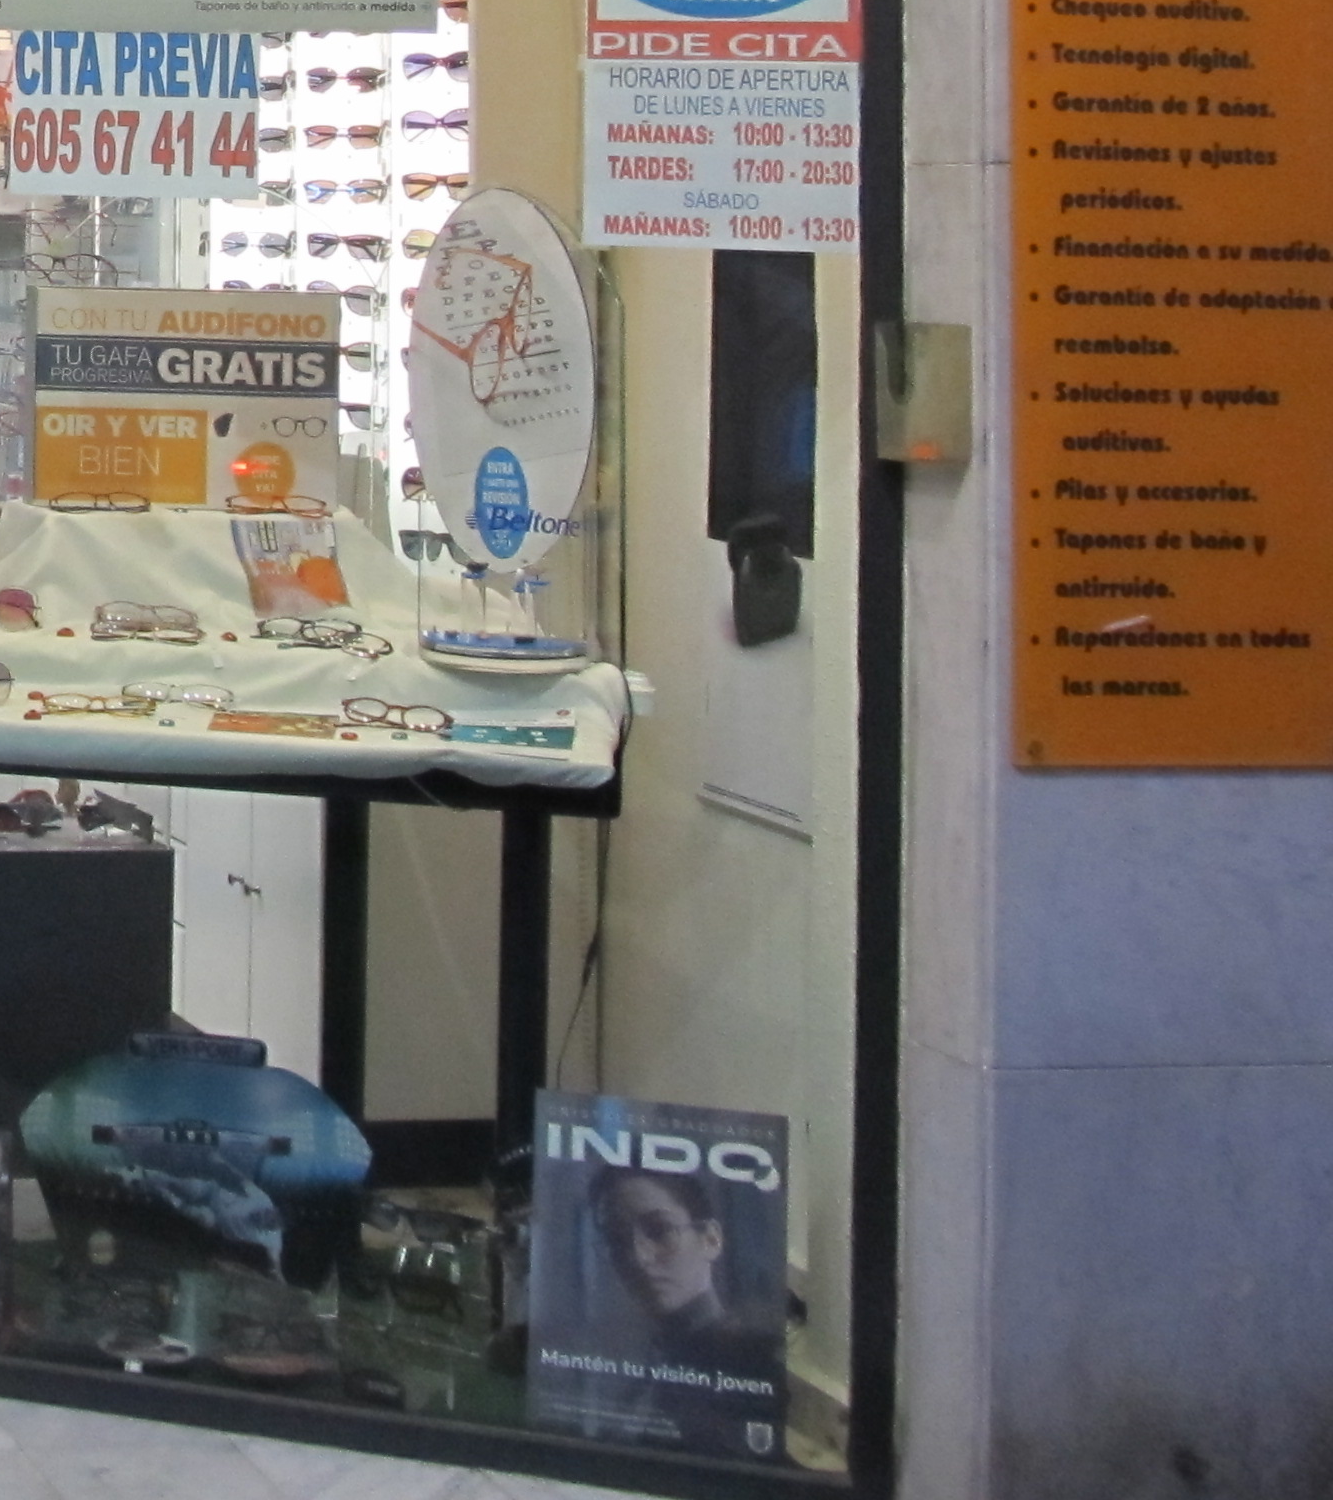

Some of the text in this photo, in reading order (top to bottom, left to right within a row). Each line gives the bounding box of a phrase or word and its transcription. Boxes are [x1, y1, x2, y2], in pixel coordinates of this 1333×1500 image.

[593, 32, 847, 58] PIDE CITA
[16, 30, 258, 98] CITA PREVIA
[610, 67, 850, 92] HORARIO DE APERTURA
[634, 95, 825, 118] DE LUNES A VIERNES
[13, 108, 256, 178] 605 67 41 44
[1053, 138, 1278, 170] Revisiones y ajustes
[607, 155, 854, 185] TARDES: 17:00 20:30
[683, 189, 759, 210] SÁBADO
[52, 344, 326, 388] TU GAFA GRATIS
[42, 413, 197, 438] OIR Y VER
[80, 445, 160, 477] BIEN
[488, 506, 580, 537] Beltone
[1055, 625, 1311, 653] Reparaciones en todas
[547, 1122, 780, 1192] INDO
[540, 1348, 773, 1396] Mantén tu visión joven
